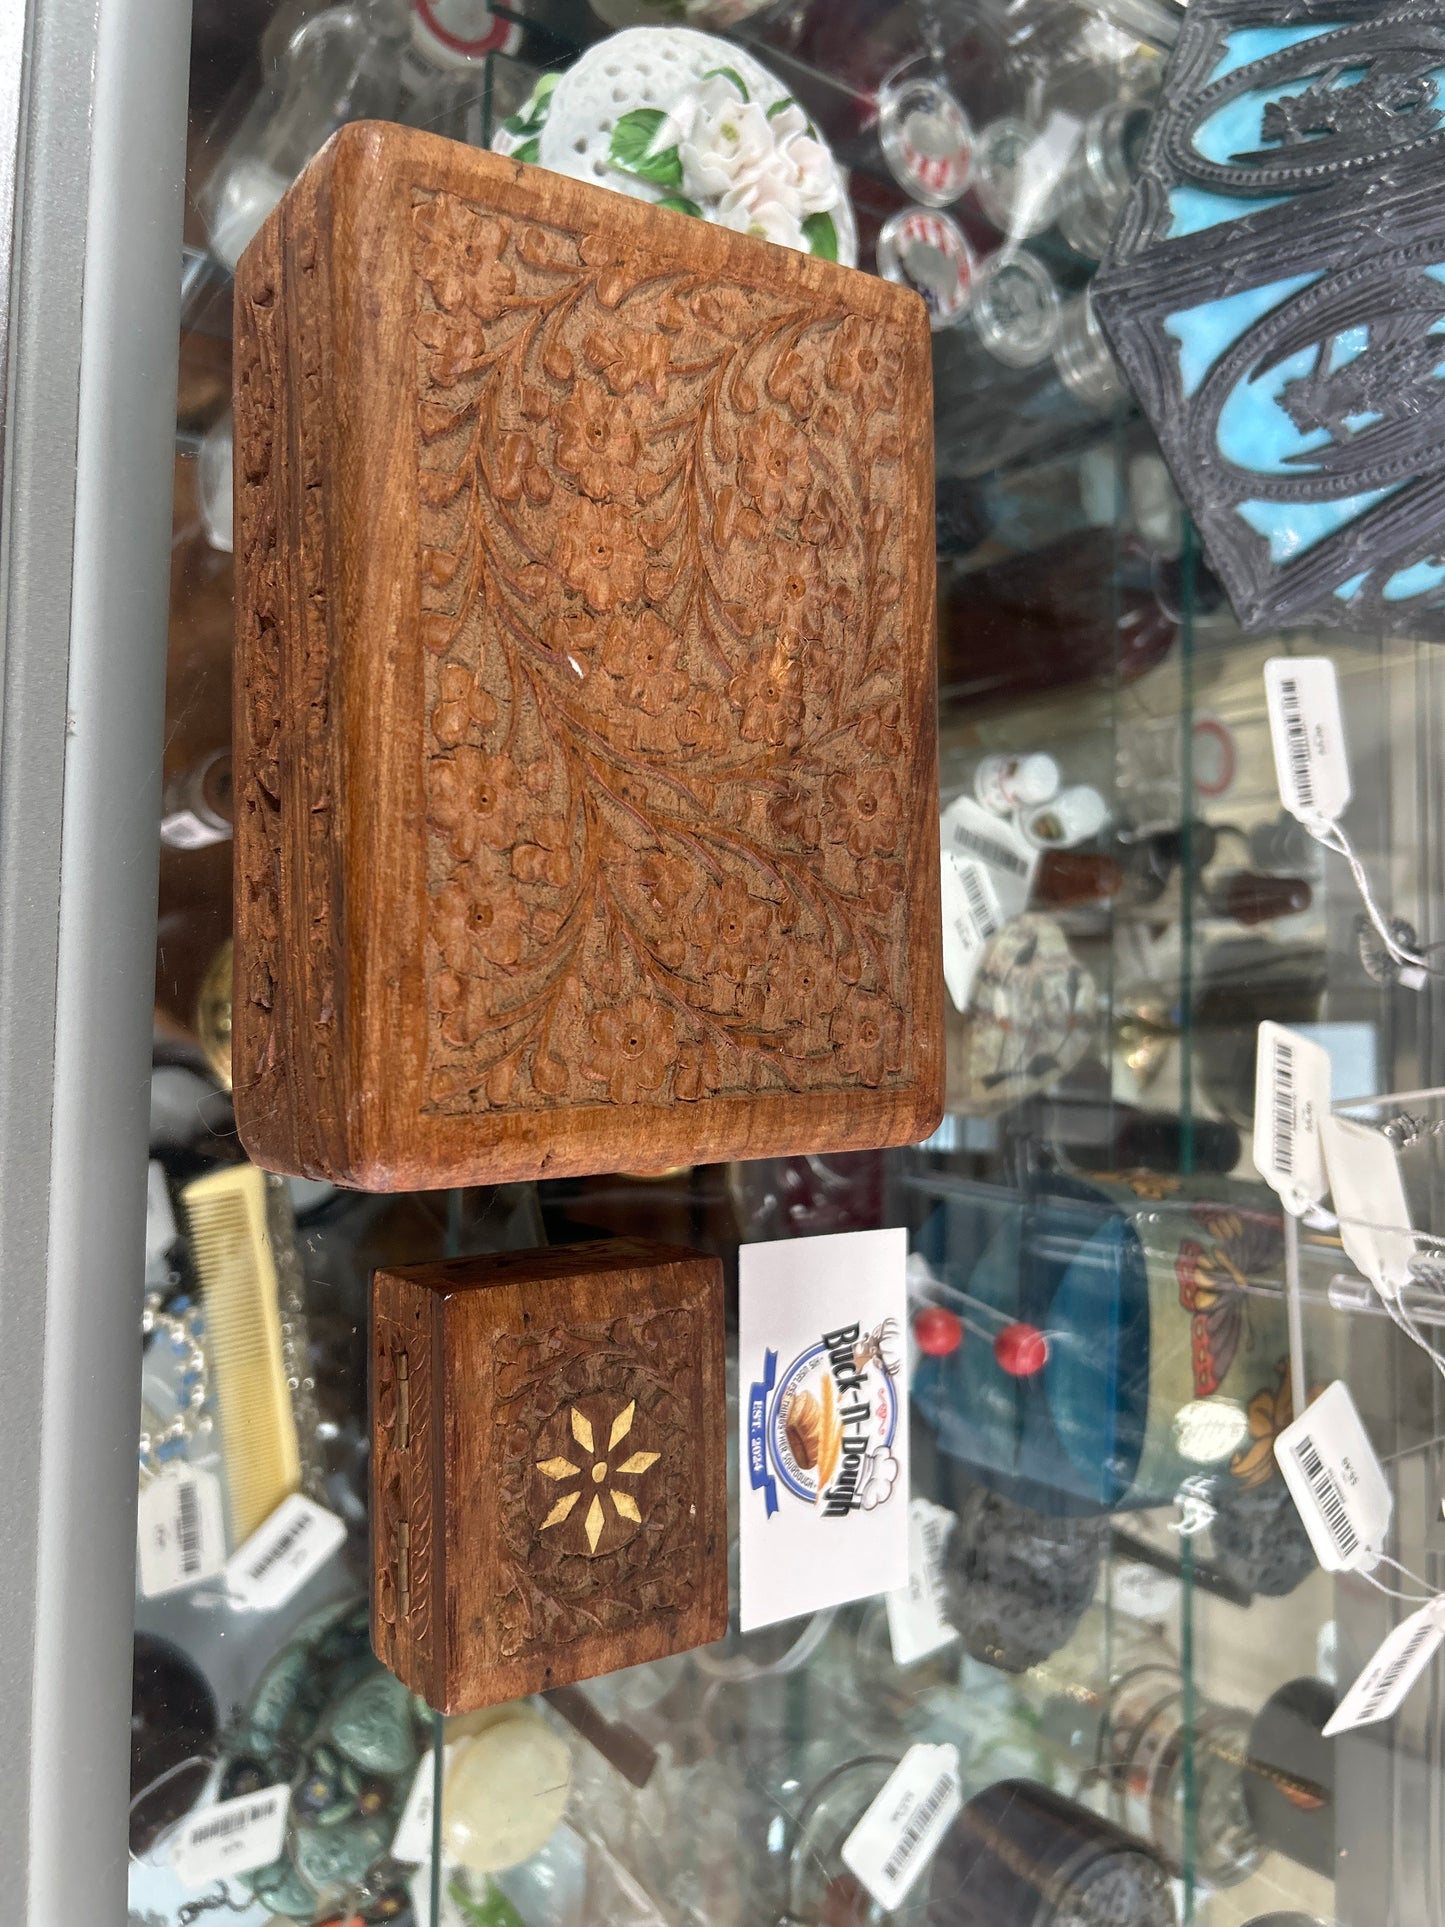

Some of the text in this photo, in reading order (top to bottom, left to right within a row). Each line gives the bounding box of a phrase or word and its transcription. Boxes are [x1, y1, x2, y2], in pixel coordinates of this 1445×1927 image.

[786, 1366, 809, 1398] USELESS
[777, 1400, 790, 1430] THINGS
[751, 1400, 764, 1471] EST. 2024
[778, 1435, 788, 1453] HER
[782, 1453, 815, 1489] SOURDOUGH
